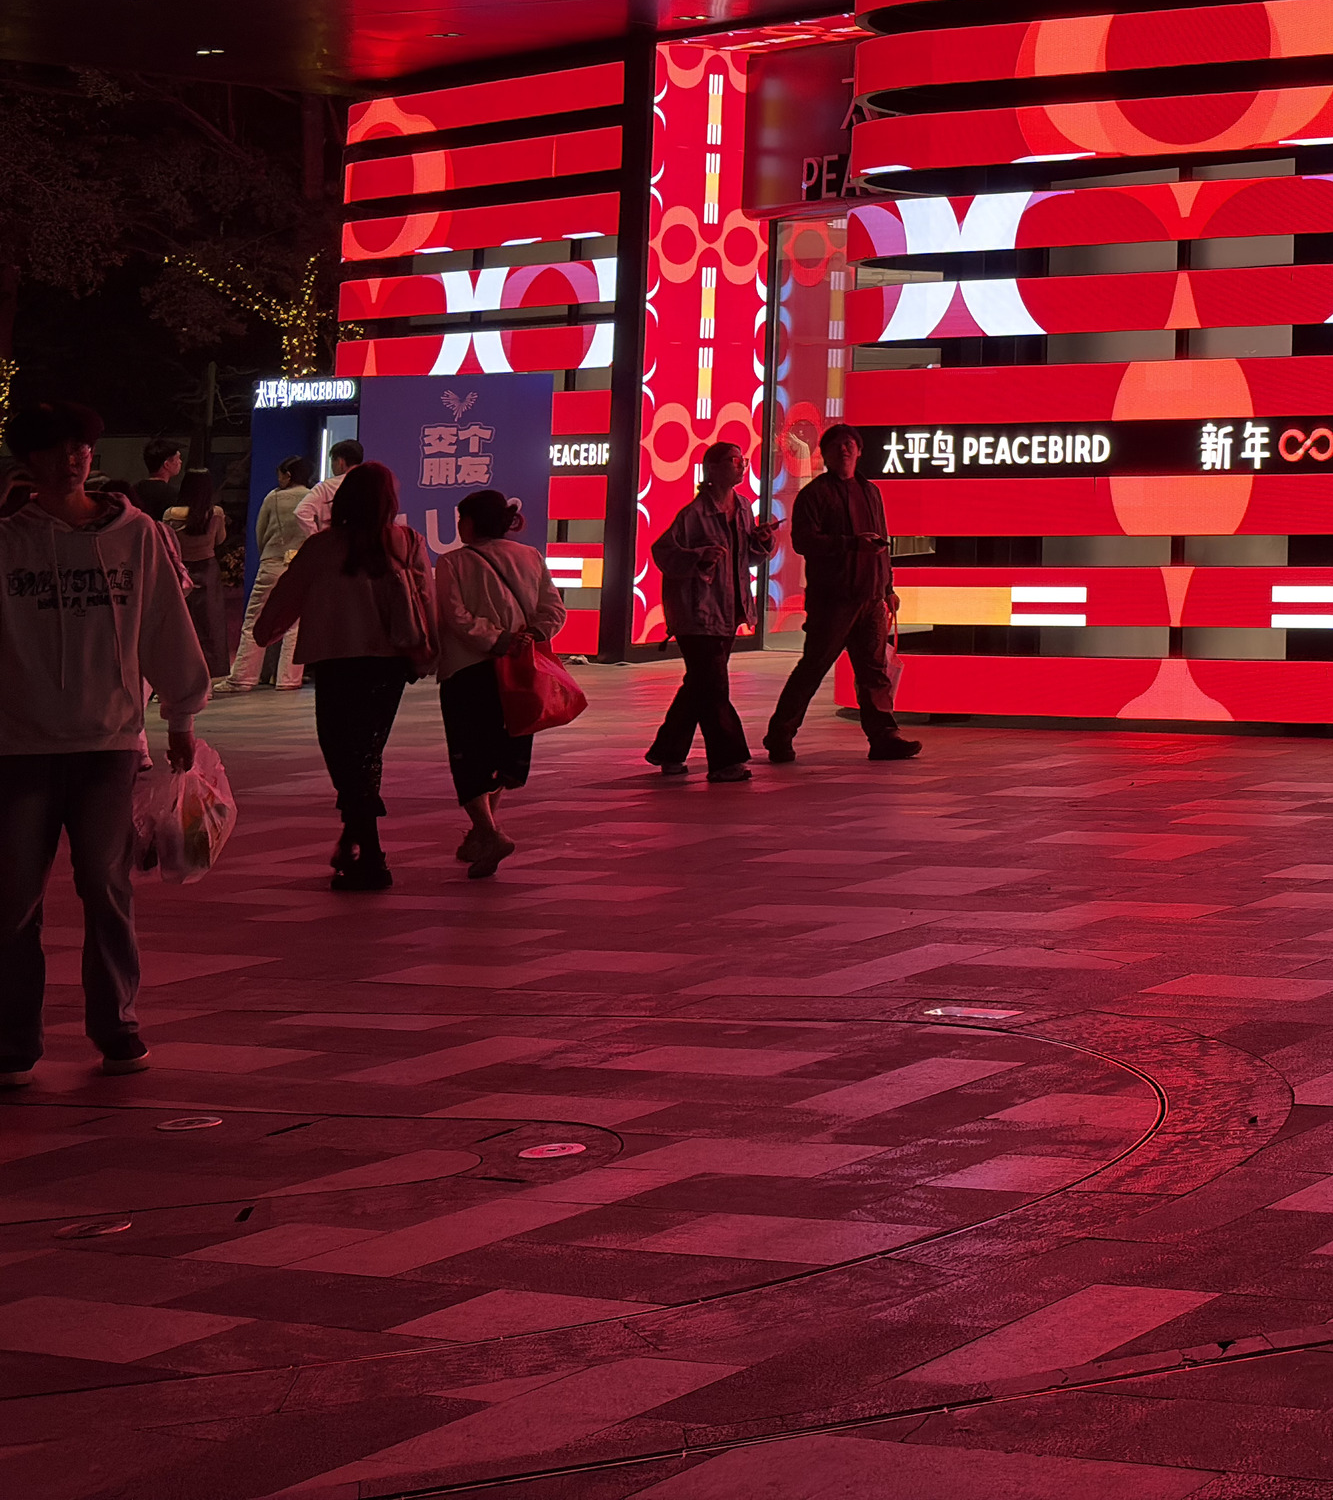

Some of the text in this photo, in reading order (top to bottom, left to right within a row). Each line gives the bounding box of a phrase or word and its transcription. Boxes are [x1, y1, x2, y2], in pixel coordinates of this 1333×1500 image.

[290, 380, 356, 402] PEACEBIRD
[423, 425, 494, 456] 交个
[882, 430, 1111, 474] 太平鸟 PEACEBIRD
[421, 456, 491, 486] 朋友
